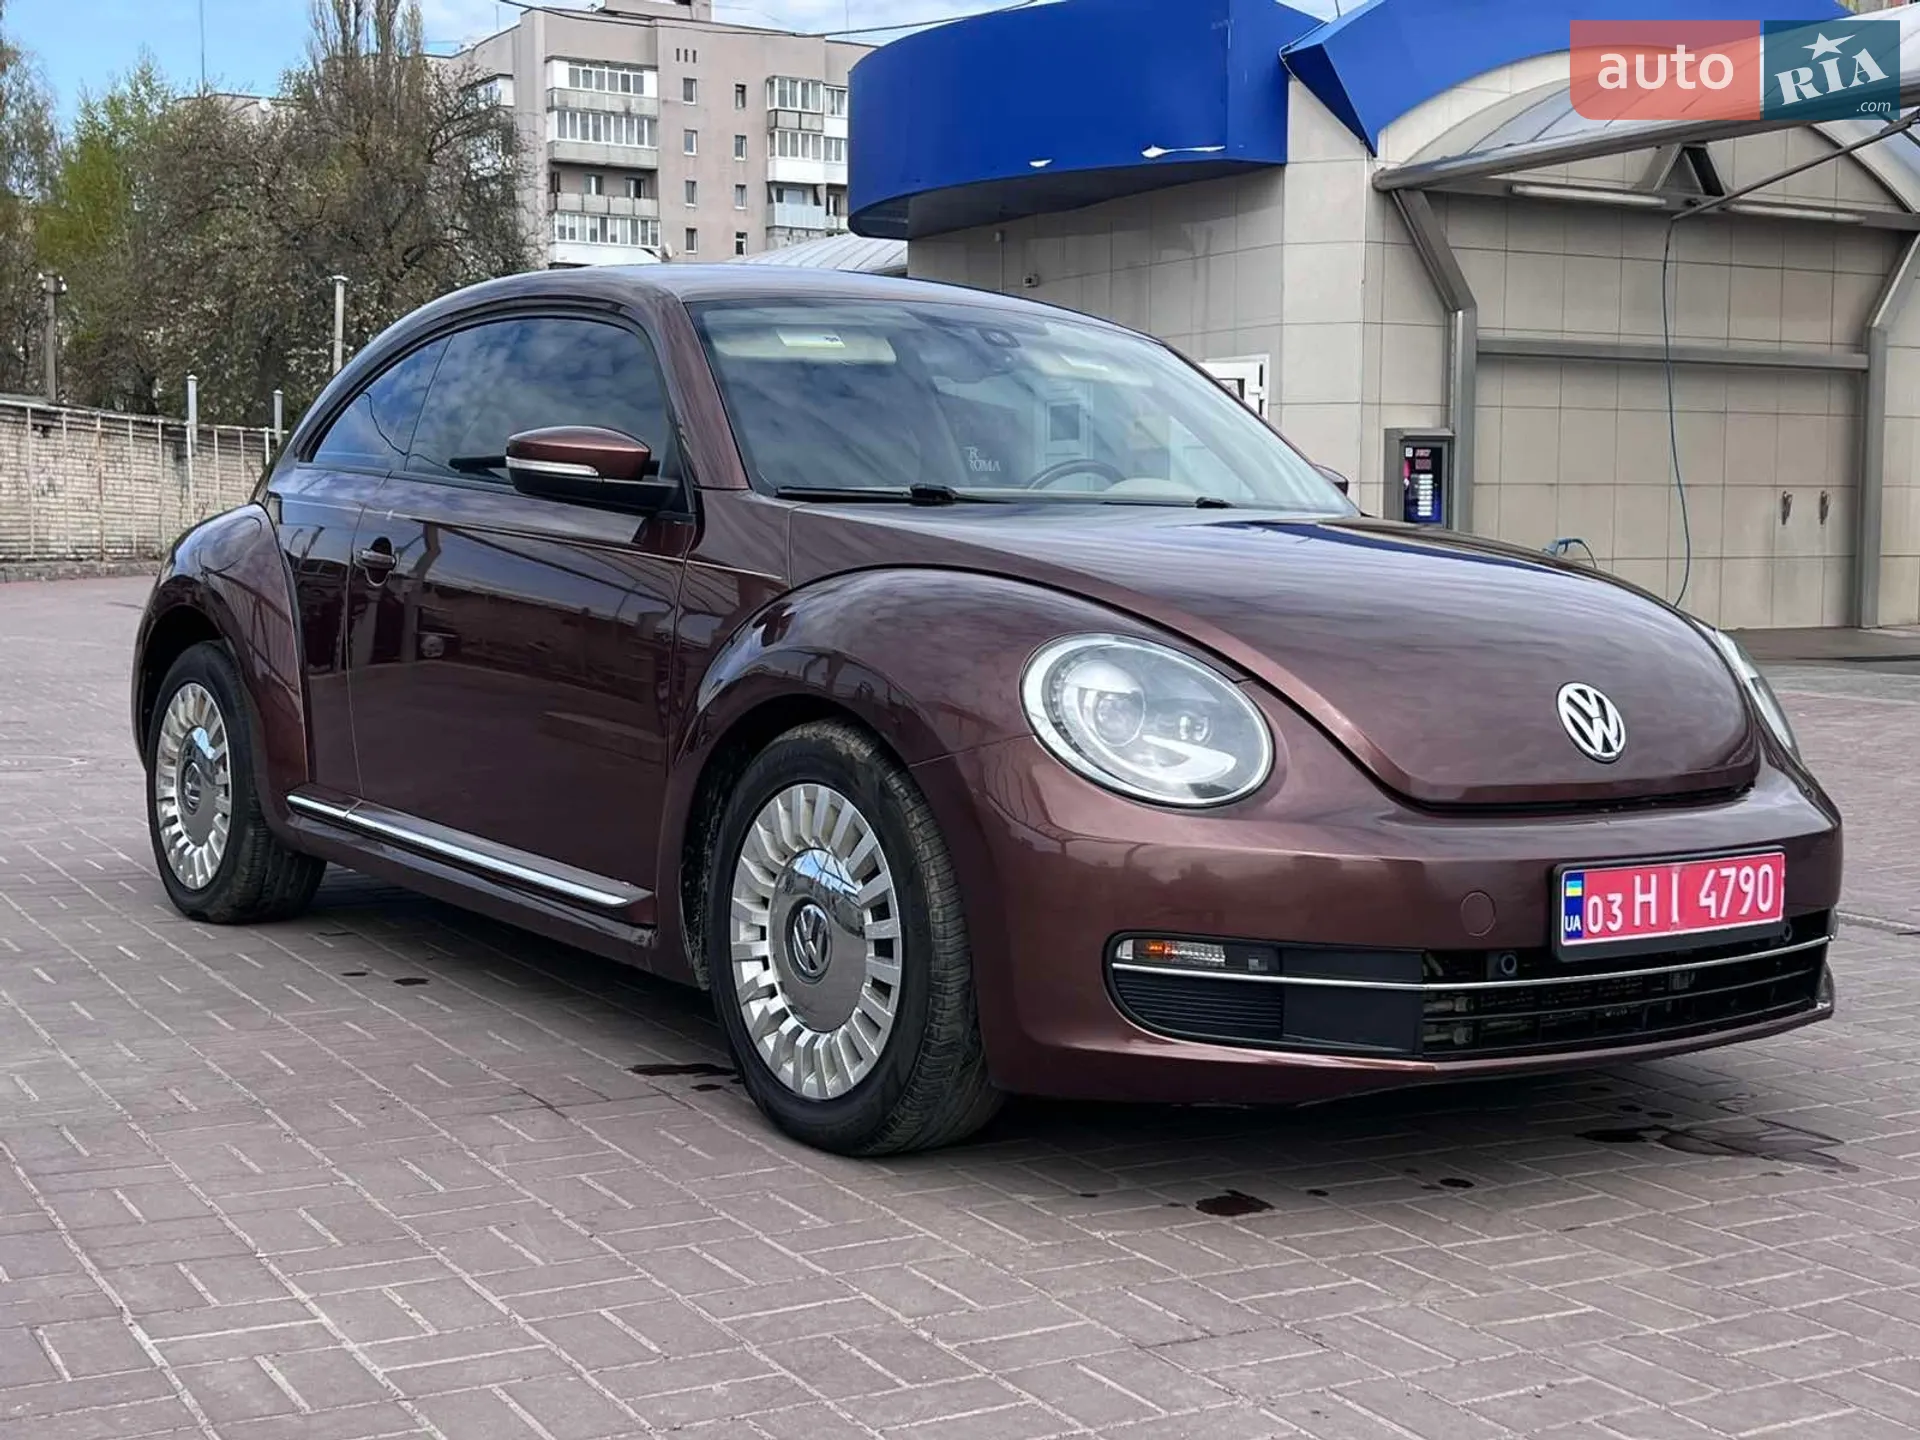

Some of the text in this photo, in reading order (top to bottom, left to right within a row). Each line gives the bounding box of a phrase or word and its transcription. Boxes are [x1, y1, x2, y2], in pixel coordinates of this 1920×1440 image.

[1587, 893, 1623, 933] 03
[1699, 864, 1774, 919] 4790
[1564, 915, 1582, 931] UA
